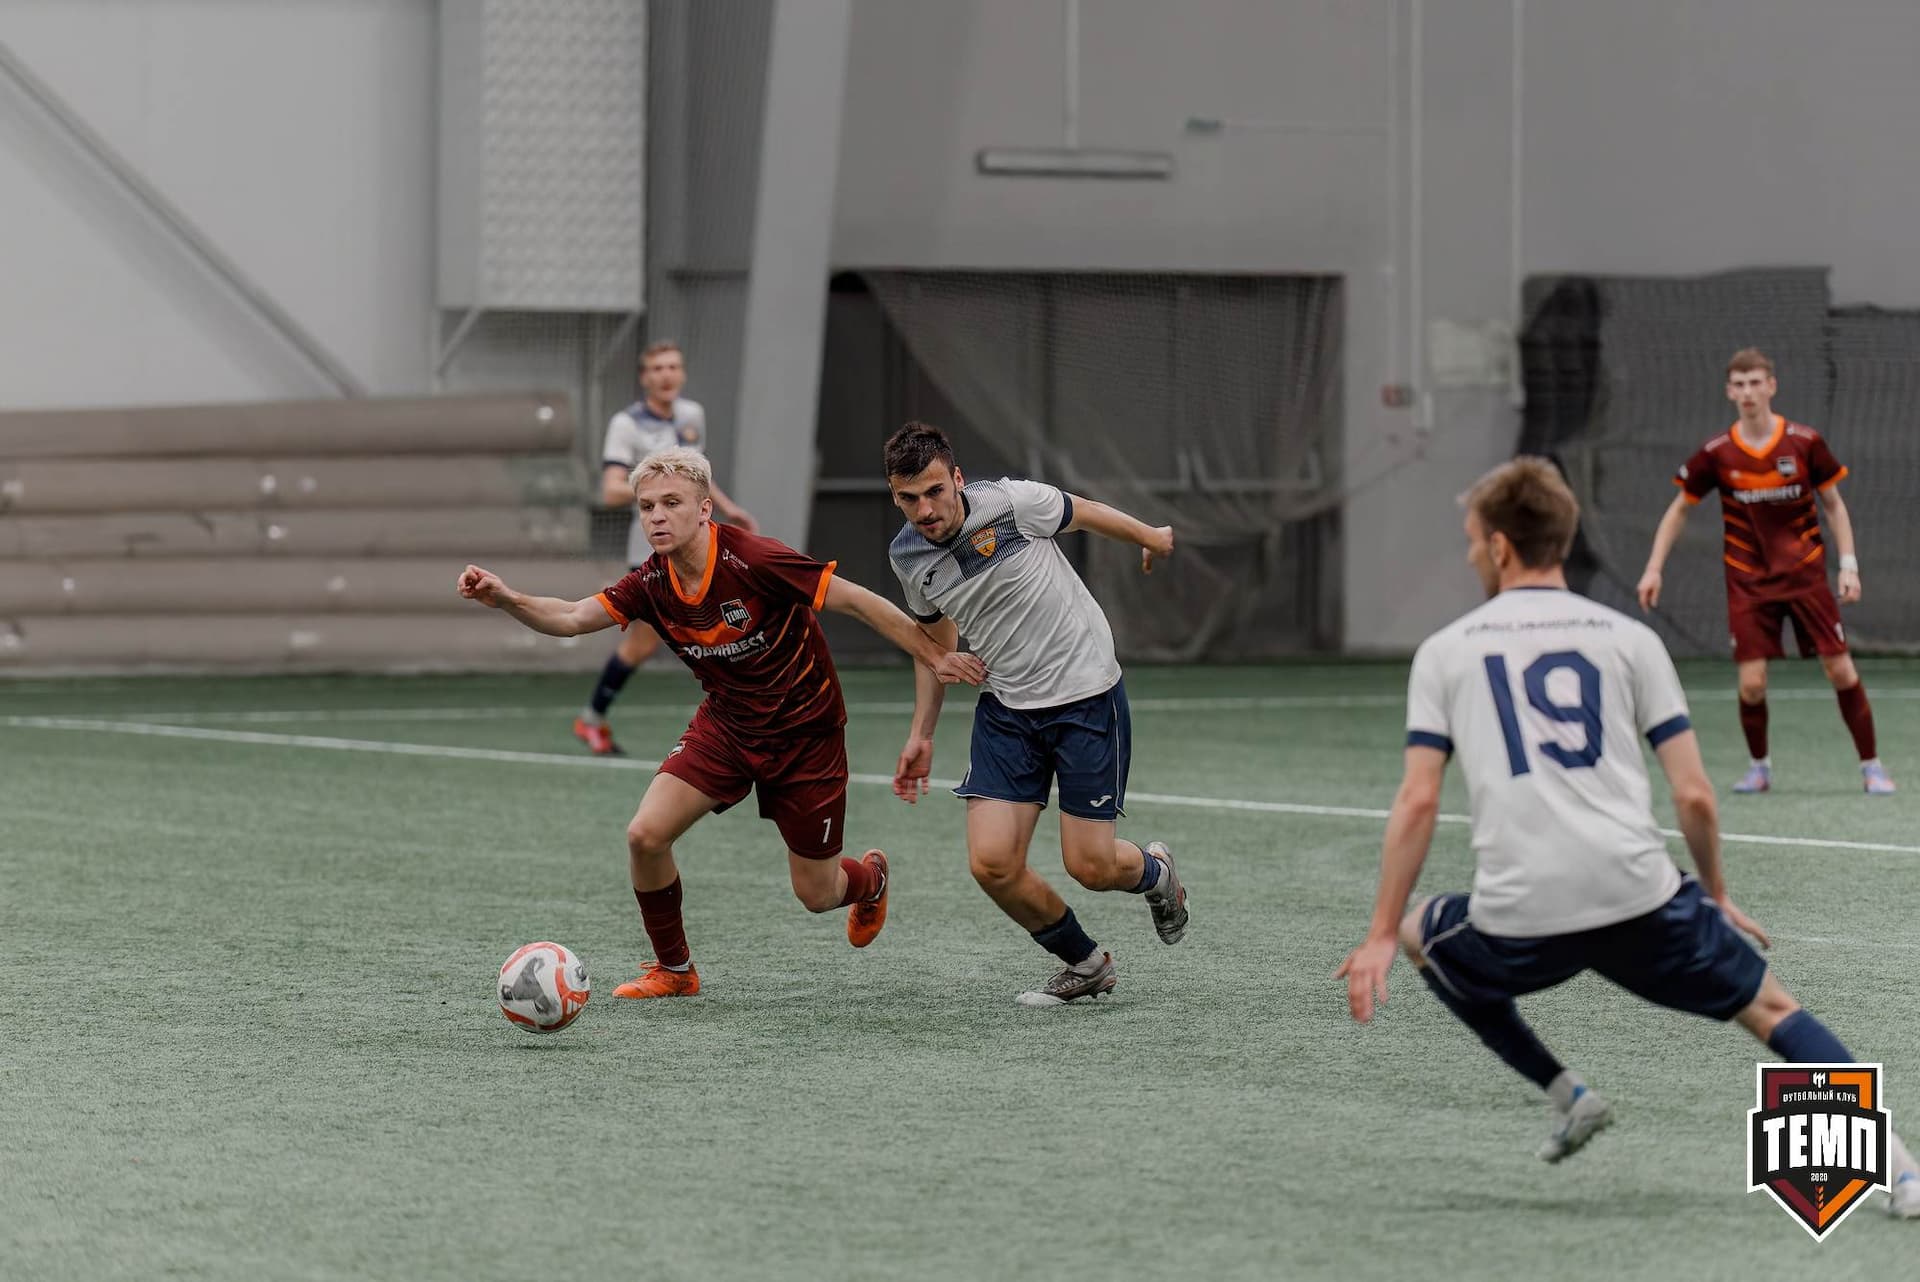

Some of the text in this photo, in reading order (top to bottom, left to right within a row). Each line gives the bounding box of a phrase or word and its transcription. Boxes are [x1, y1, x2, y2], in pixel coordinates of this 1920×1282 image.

[725, 608, 748, 624] ТЕМП
[1484, 650, 1603, 777] 19
[822, 817, 832, 844] 7
